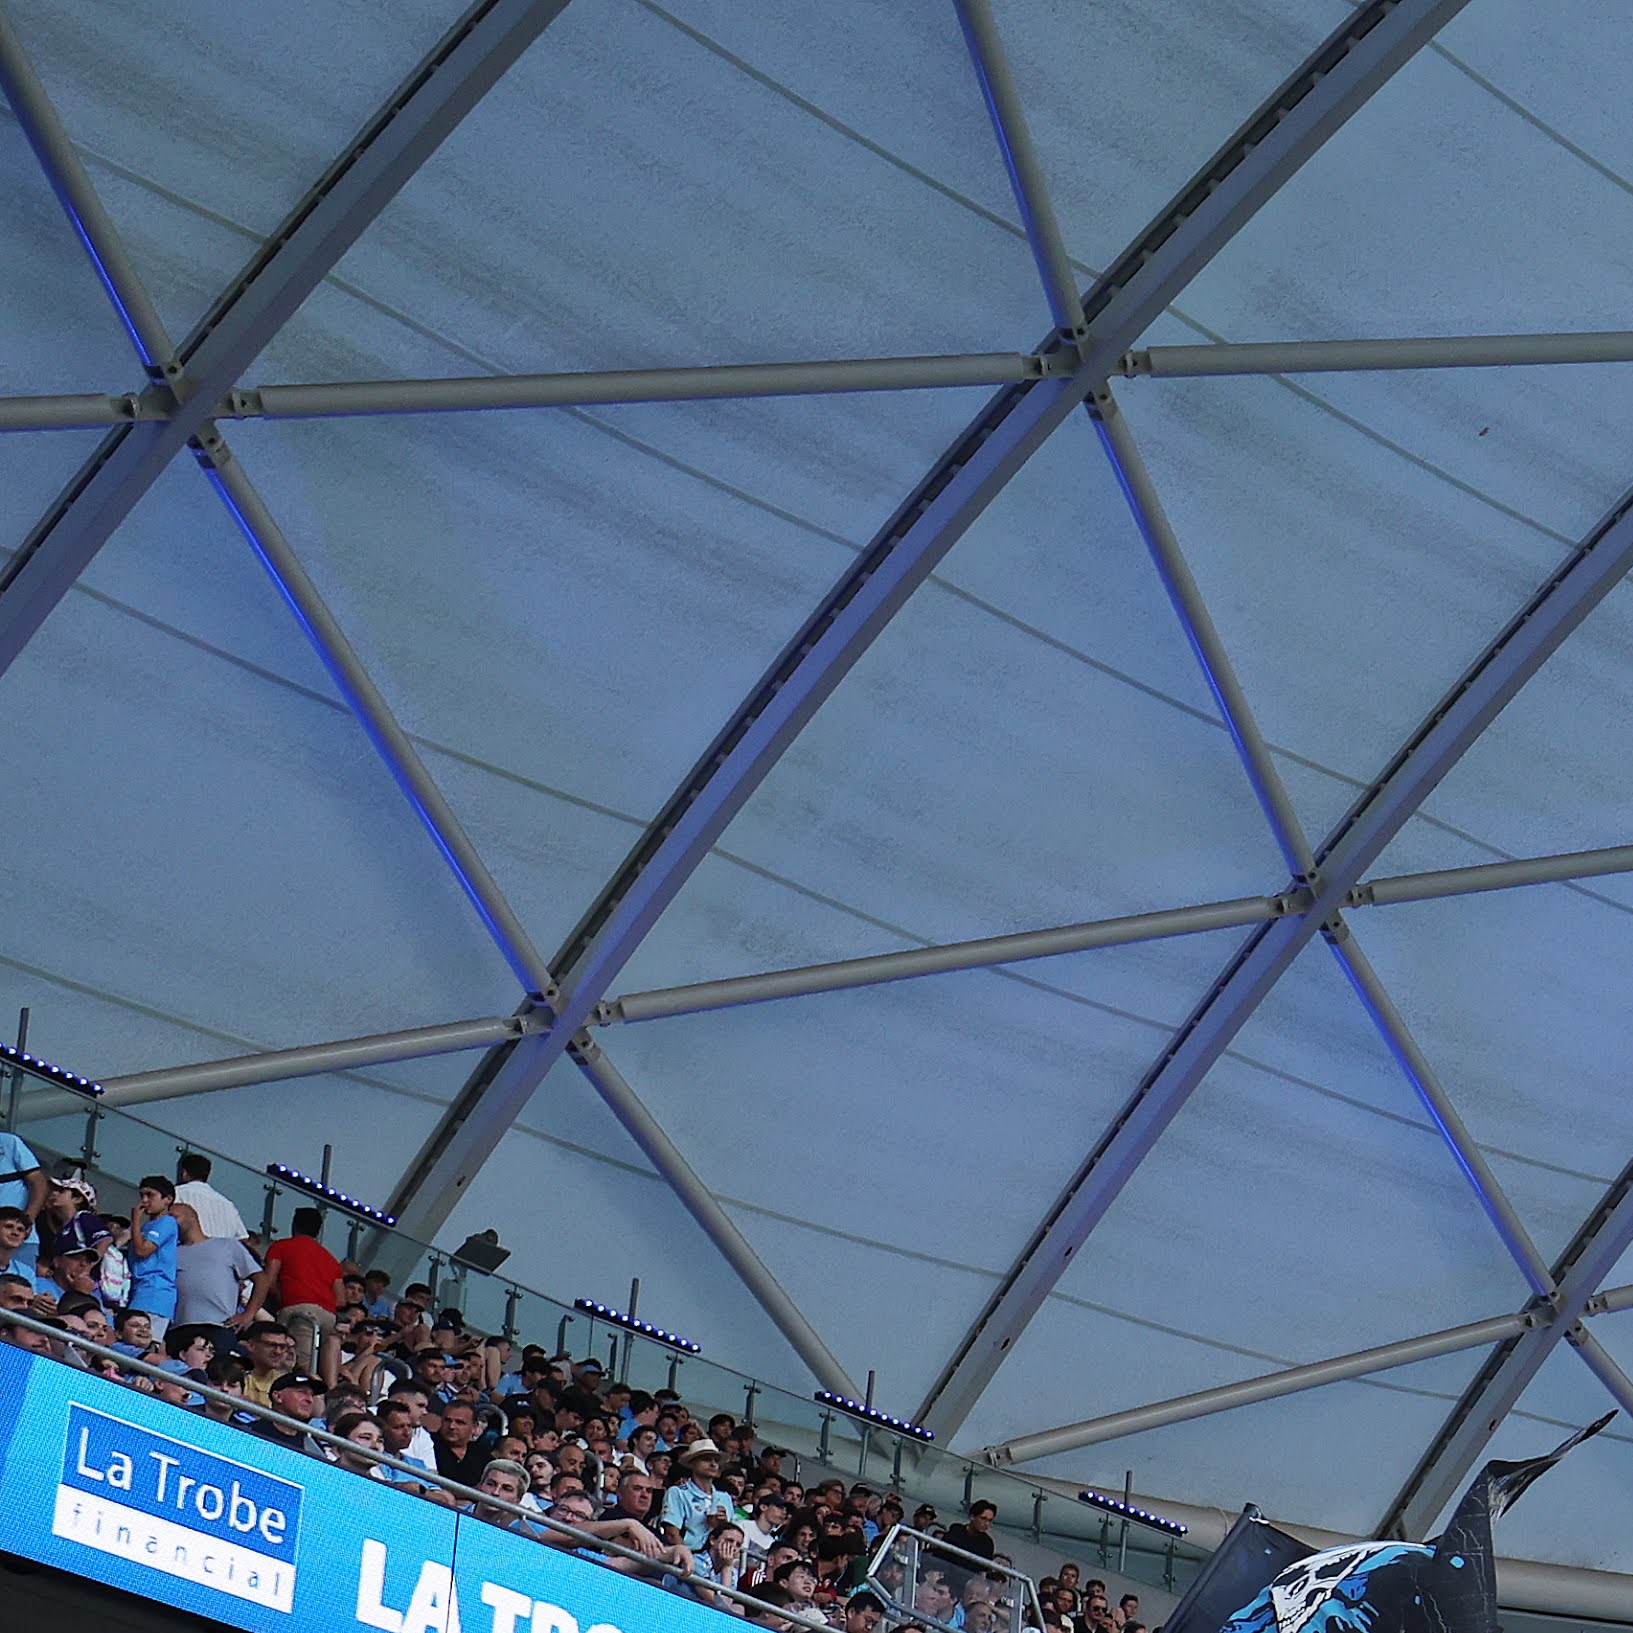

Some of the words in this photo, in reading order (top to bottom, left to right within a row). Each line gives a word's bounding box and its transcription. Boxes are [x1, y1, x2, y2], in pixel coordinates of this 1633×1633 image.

[77, 1426, 133, 1491] La
[149, 1451, 286, 1544] Trobe
[71, 1502, 281, 1596] financial
